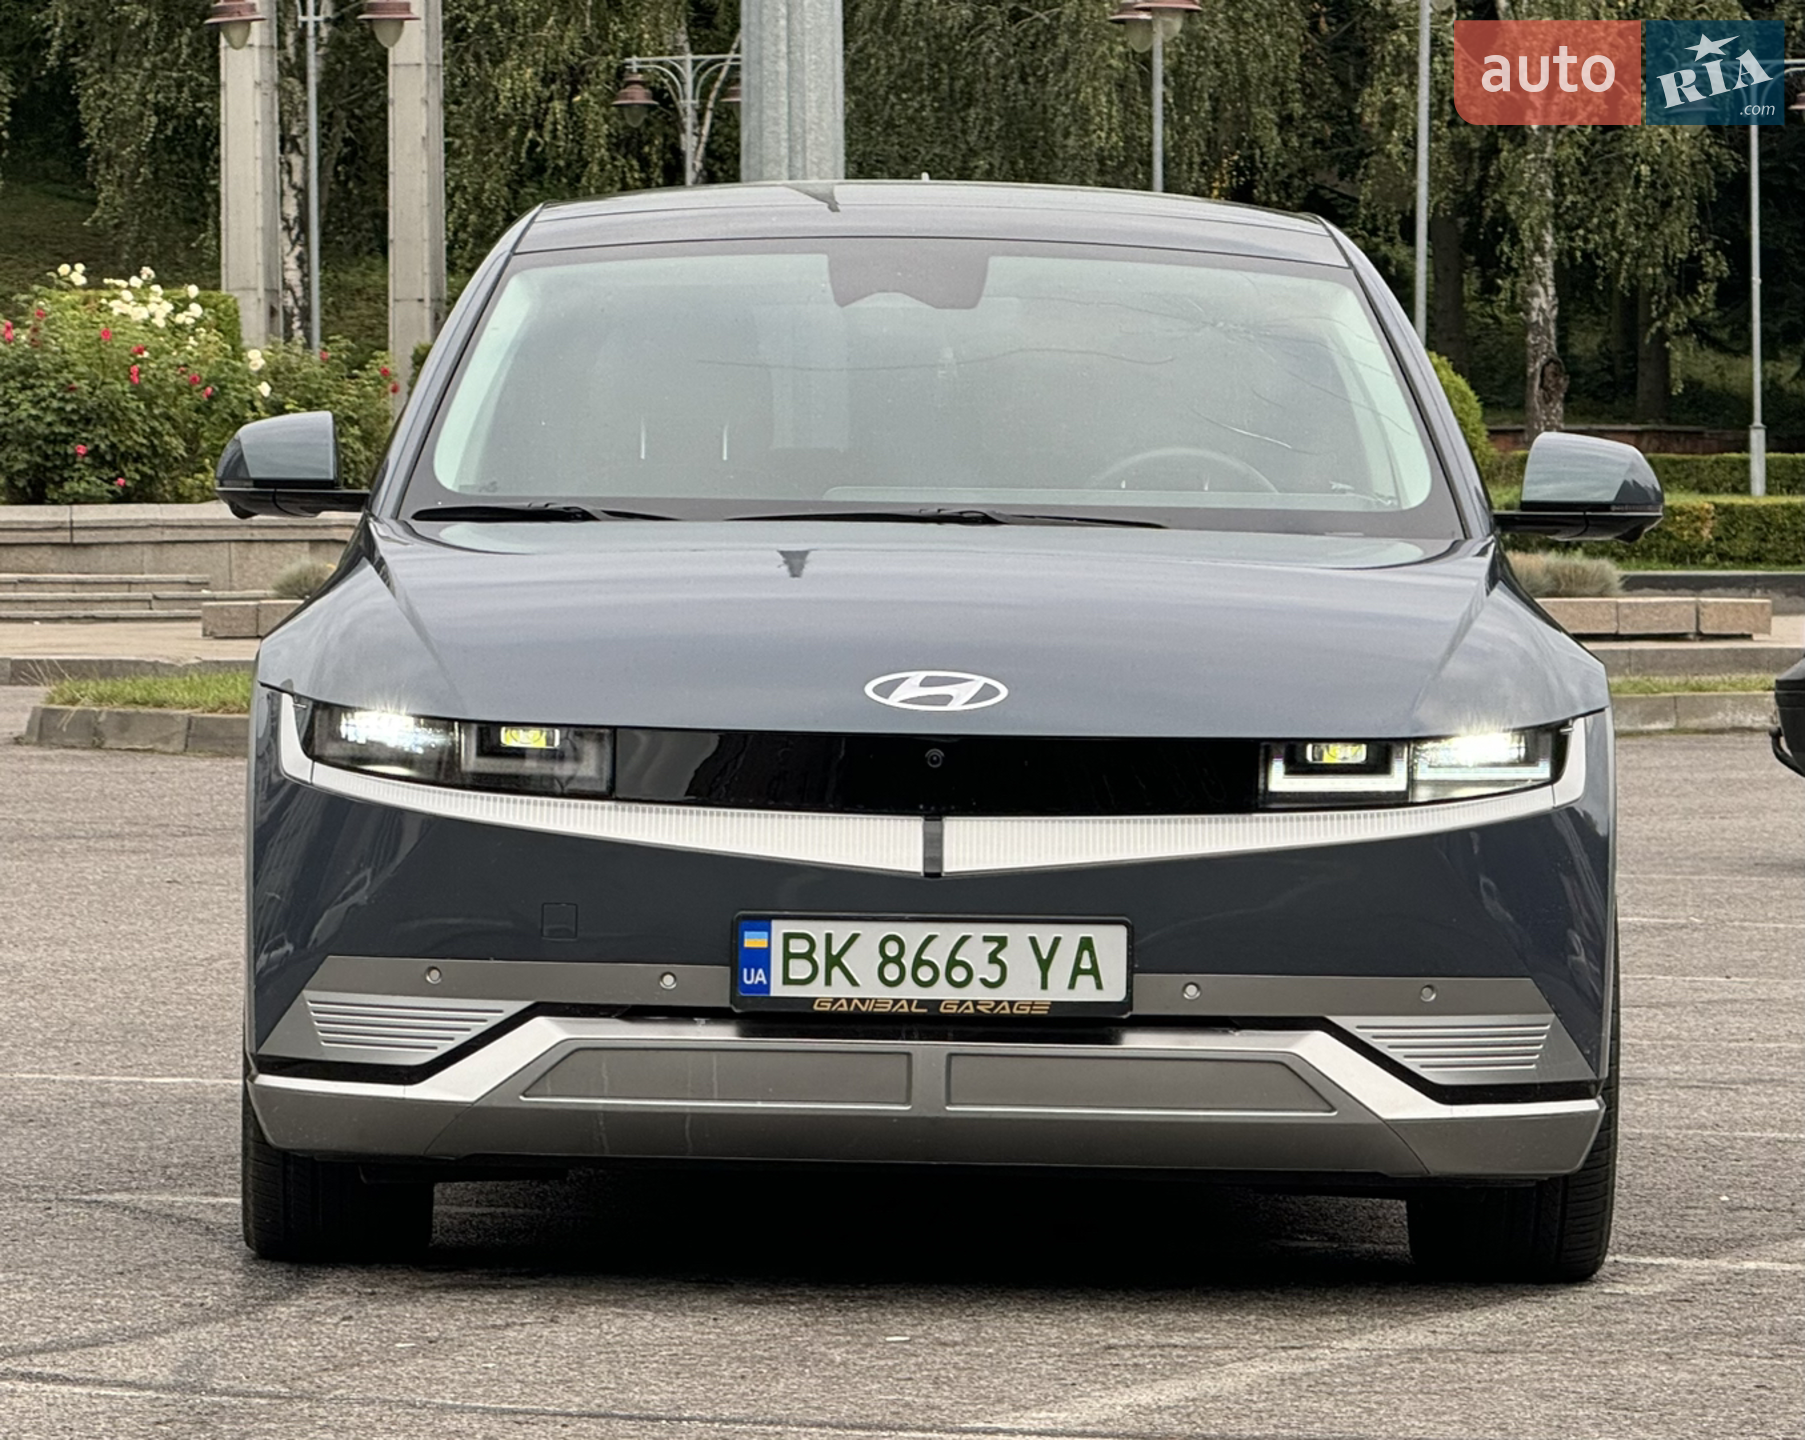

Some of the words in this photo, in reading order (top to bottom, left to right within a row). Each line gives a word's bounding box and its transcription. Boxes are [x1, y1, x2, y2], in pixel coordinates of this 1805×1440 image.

[782, 931, 861, 987] BK
[877, 934, 1008, 989] 8663
[1028, 935, 1104, 990] YA
[743, 967, 767, 985] UA
[812, 998, 928, 1013] GANIBAL
[938, 1000, 1052, 1015] GARAGE
